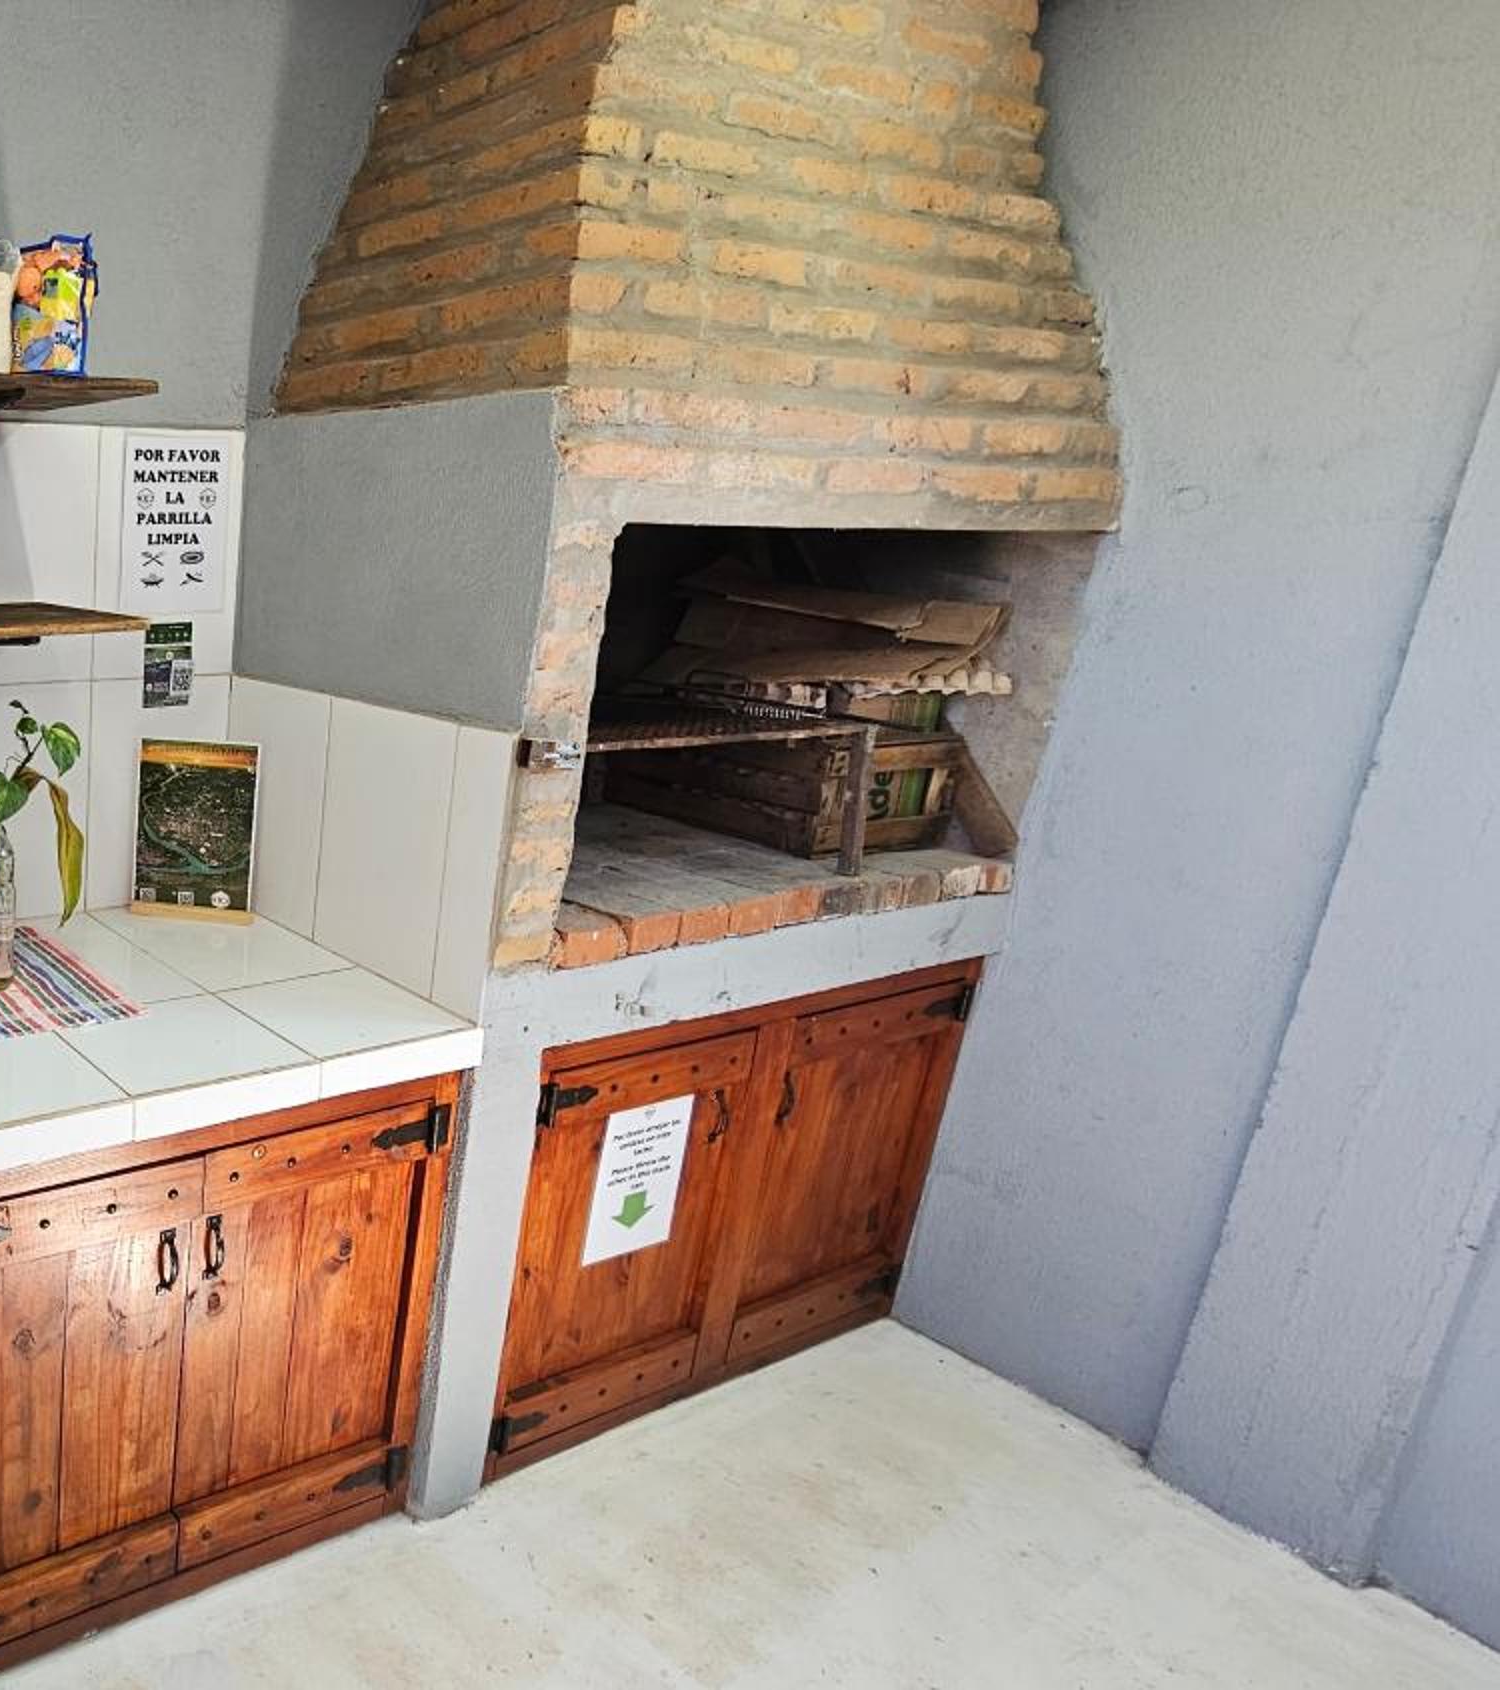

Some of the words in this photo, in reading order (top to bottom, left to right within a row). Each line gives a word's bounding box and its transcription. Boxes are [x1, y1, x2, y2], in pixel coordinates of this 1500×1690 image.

[134, 448, 164, 462] POR
[168, 449, 221, 463] FAVOR
[133, 470, 219, 484] MANTENER
[165, 491, 185, 505] LA
[136, 511, 212, 526] PARRILLA
[147, 533, 200, 546] LIMPIA
